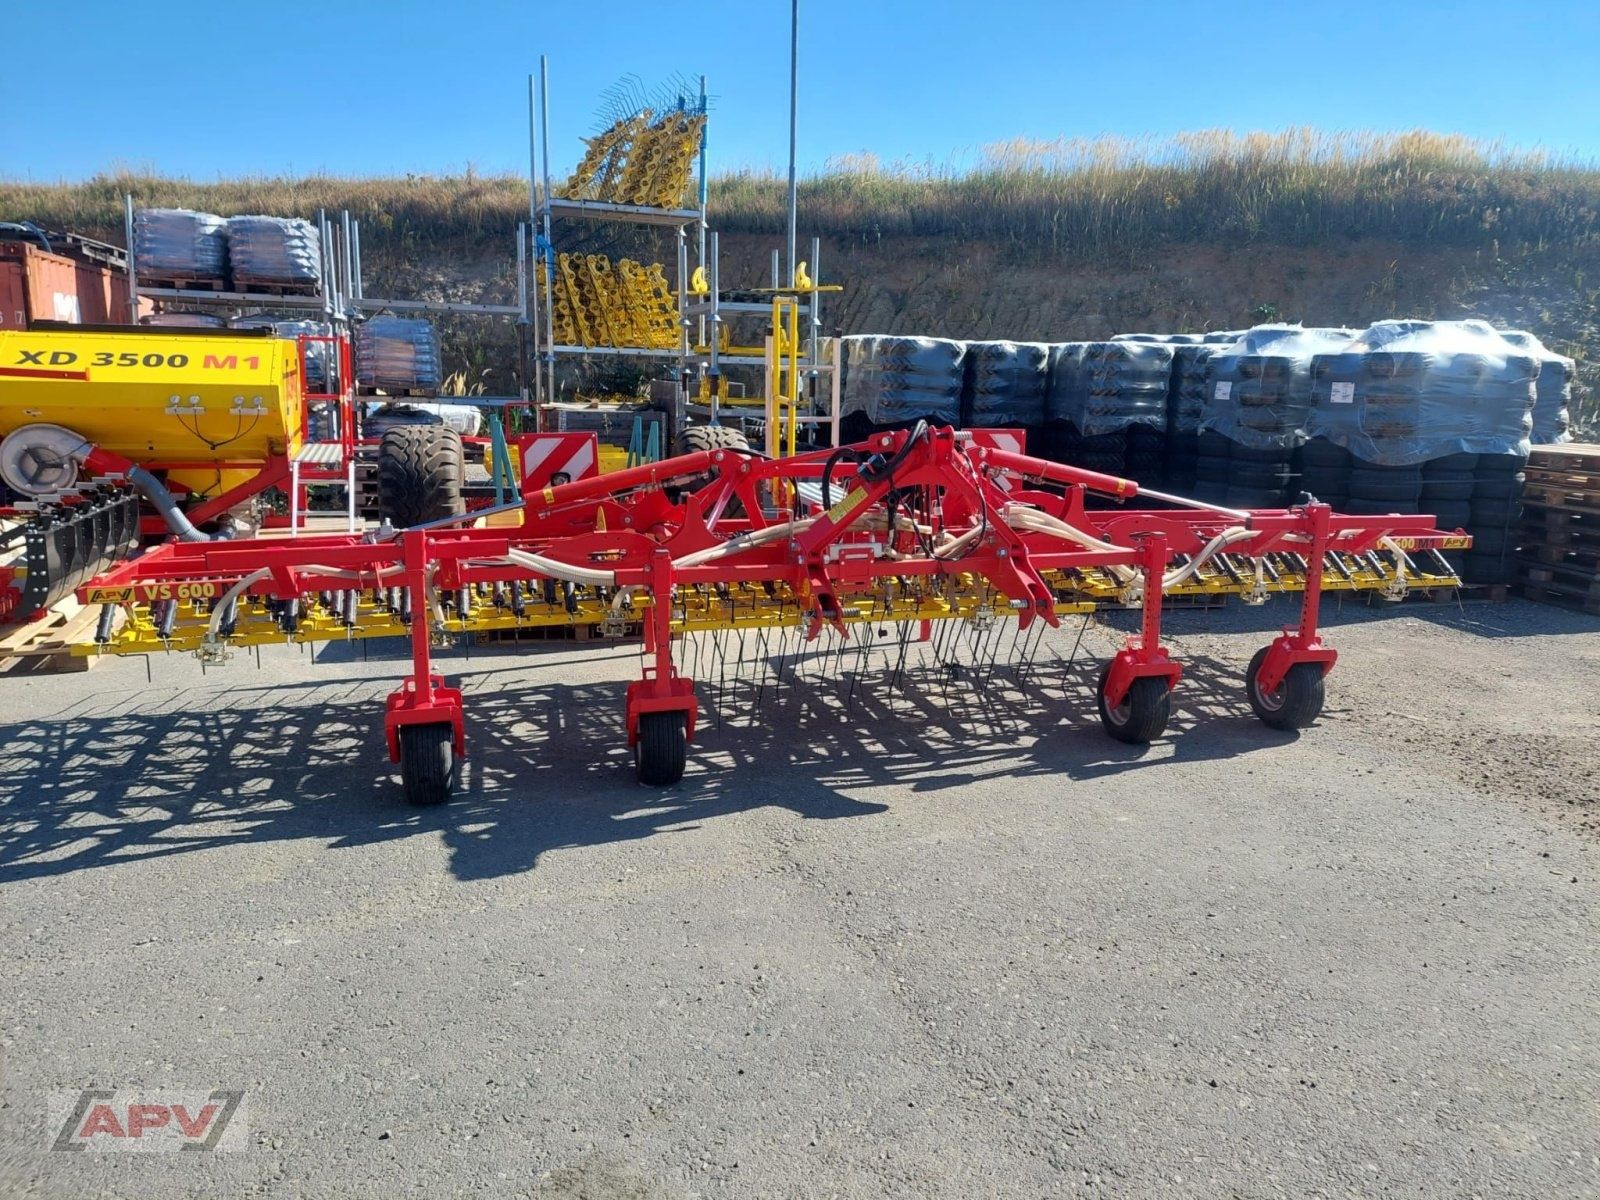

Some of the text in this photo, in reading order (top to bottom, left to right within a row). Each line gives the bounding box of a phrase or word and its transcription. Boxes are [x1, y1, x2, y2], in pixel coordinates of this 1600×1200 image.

[15, 350, 260, 369] XD 3500 M1
[94, 589, 128, 601] APV
[144, 585, 172, 600] VS
[177, 583, 215, 598] 600
